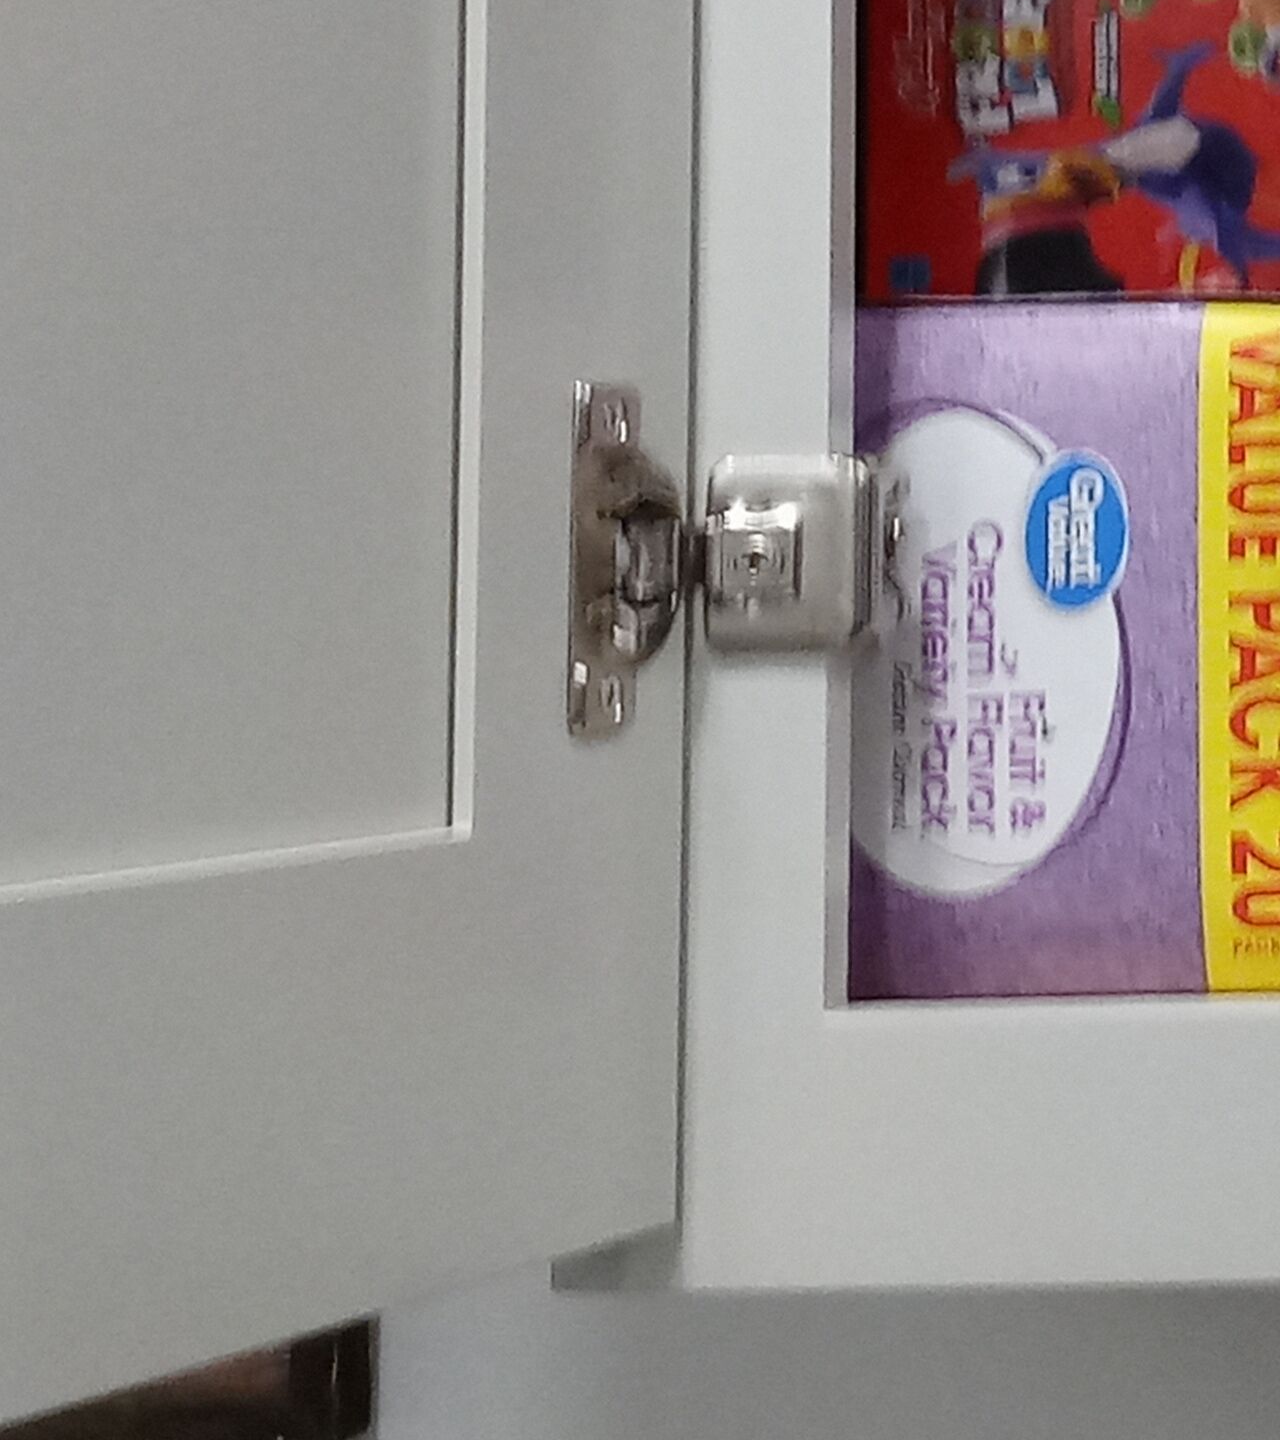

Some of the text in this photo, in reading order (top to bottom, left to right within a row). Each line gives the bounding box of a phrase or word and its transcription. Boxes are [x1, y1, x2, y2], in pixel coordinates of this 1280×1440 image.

[909, 541, 959, 834] Variety Pack
[966, 520, 1006, 833] Cream Flavor
